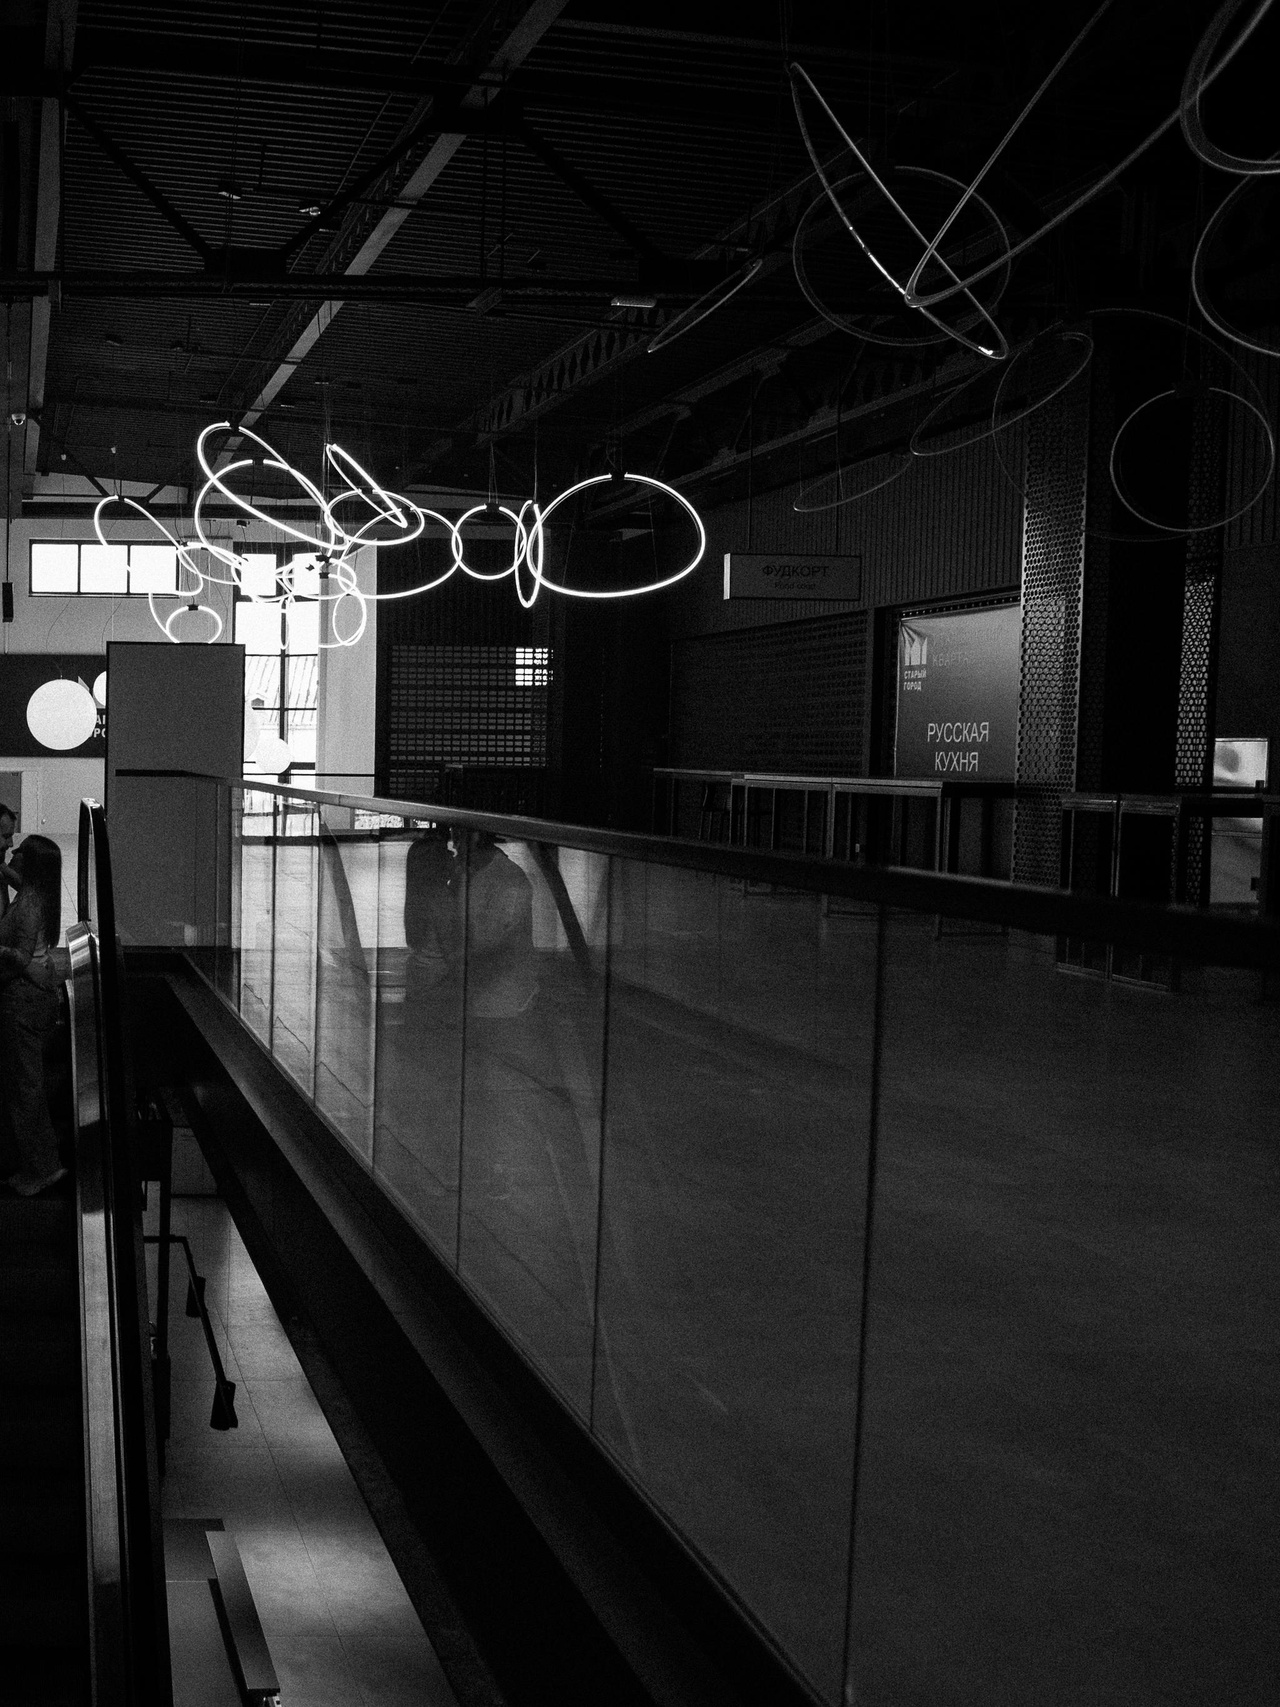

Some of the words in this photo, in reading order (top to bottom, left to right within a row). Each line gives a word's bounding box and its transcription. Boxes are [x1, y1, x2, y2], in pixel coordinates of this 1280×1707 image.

[762, 565, 829, 579] ФУДКОРТ
[904, 668, 927, 680] СТАРЫЙ
[903, 681, 922, 691] ГОРОД
[927, 722, 989, 743] РУССКАЯ
[935, 751, 979, 772] КУХНЯ
